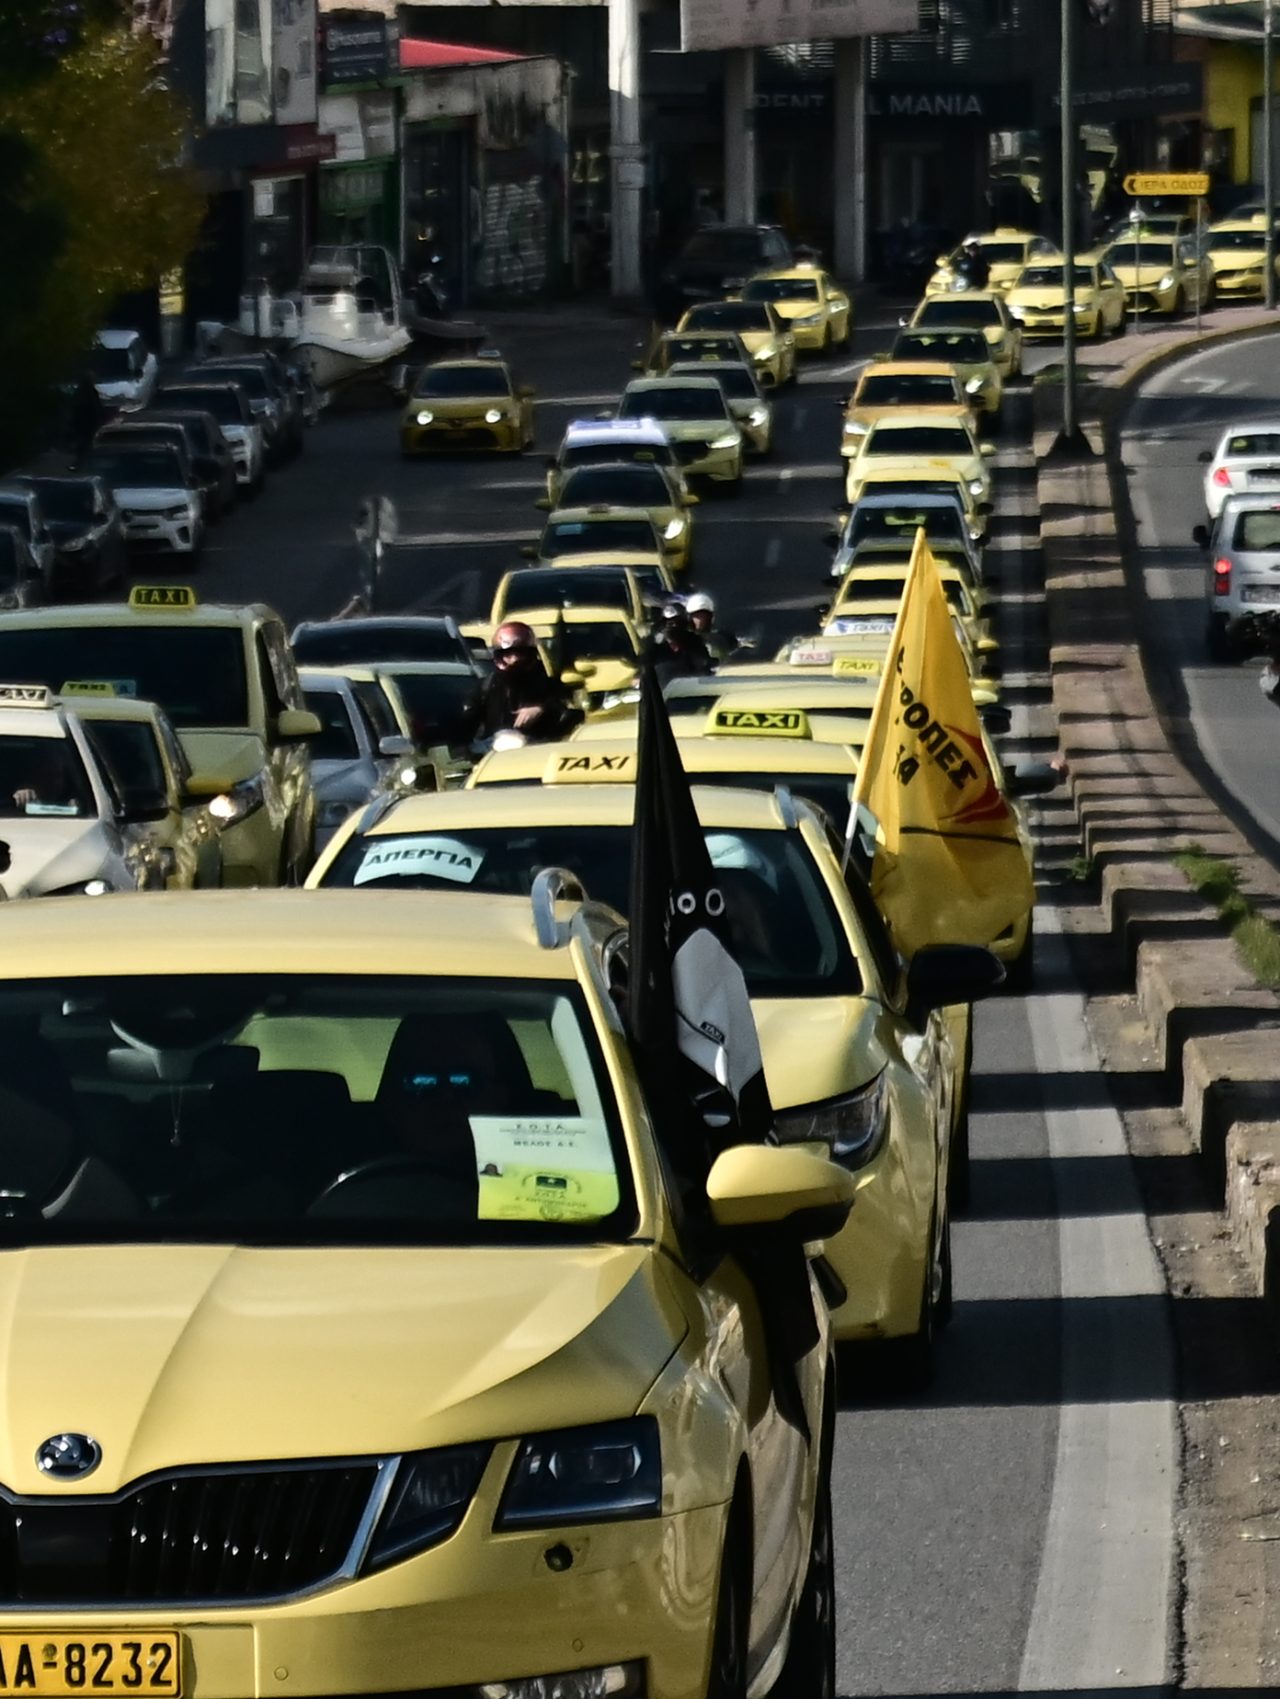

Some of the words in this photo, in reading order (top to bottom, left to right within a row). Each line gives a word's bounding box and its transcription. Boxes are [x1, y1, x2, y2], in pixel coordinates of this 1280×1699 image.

[889, 95, 982, 116] MANIA
[140, 590, 186, 603] TAXI
[840, 661, 875, 671] TAXI
[723, 712, 800, 729] TAXI
[558, 756, 631, 771] TAXI
[365, 848, 473, 870] ΑΠΕΡΓΙΑ
